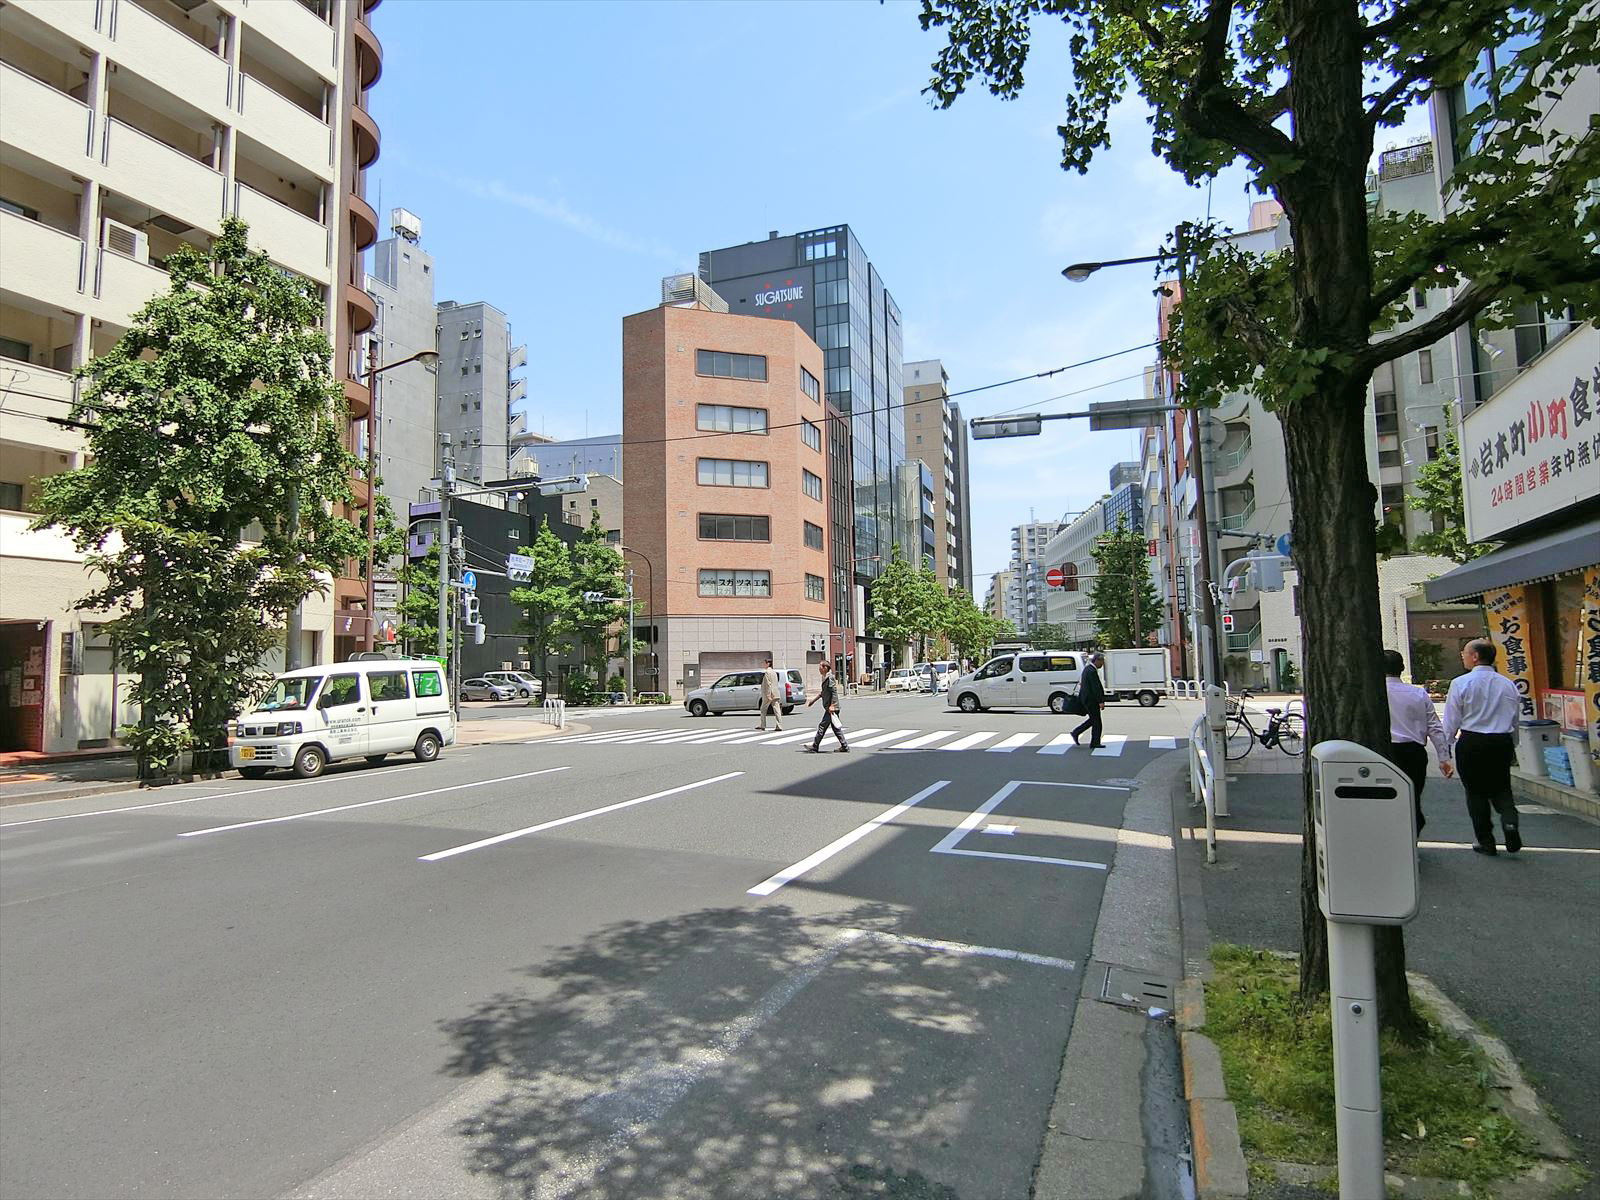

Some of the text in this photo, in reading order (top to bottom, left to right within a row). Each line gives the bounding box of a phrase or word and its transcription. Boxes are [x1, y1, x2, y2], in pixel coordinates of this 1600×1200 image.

[755, 286, 804, 307] SUGATSUNE
[718, 578, 769, 587] スガツネ工業
